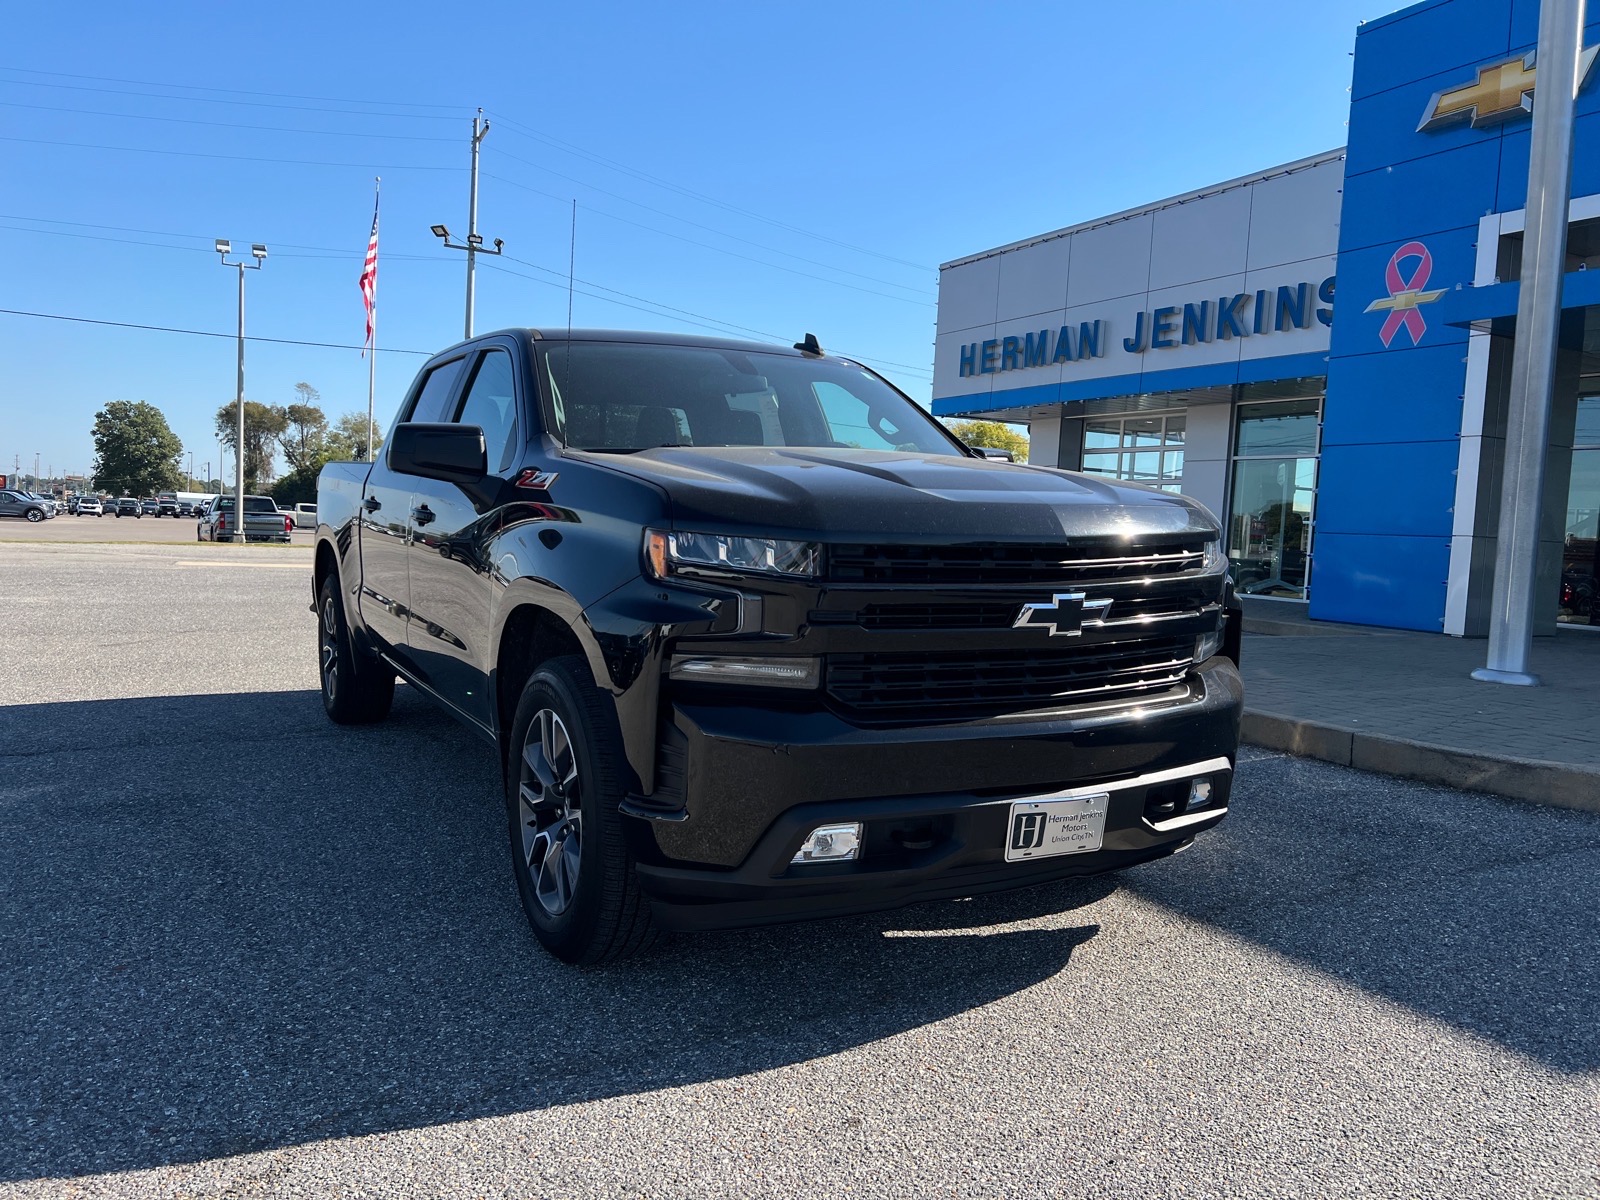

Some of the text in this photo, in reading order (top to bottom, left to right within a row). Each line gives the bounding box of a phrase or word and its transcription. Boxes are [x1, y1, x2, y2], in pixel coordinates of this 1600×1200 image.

[959, 276, 1336, 378] HERMAN JENKINS
[515, 470, 559, 490] Z71
[1048, 811, 1103, 823] Herman Jenkins
[1061, 824, 1088, 832] Motors
